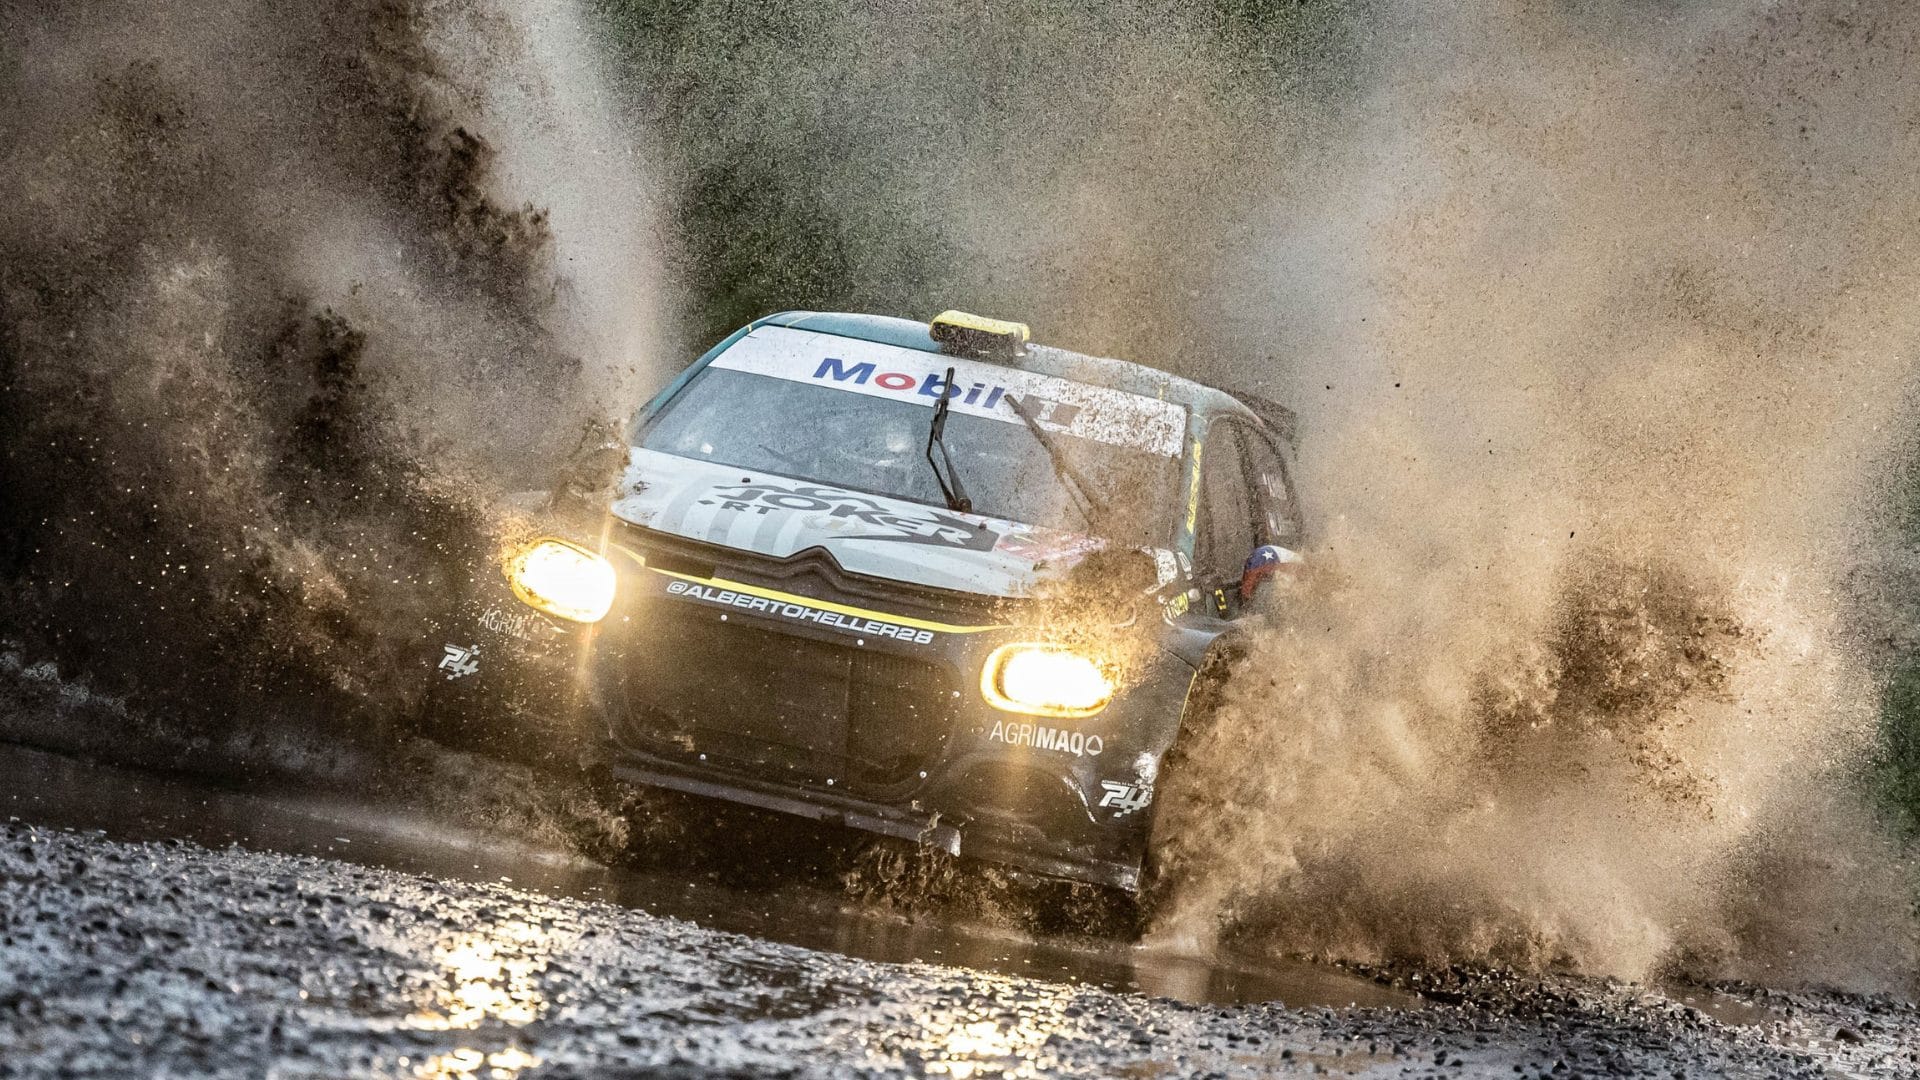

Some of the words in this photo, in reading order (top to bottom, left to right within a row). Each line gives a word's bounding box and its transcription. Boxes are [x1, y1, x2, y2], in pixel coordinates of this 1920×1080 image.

[812, 357, 1005, 409] Mobil
[715, 488, 973, 546] JOKER
[721, 501, 780, 515] RT
[666, 580, 935, 645] @ALBERTOHELLER28
[989, 720, 1085, 757] AGRIMAQ
